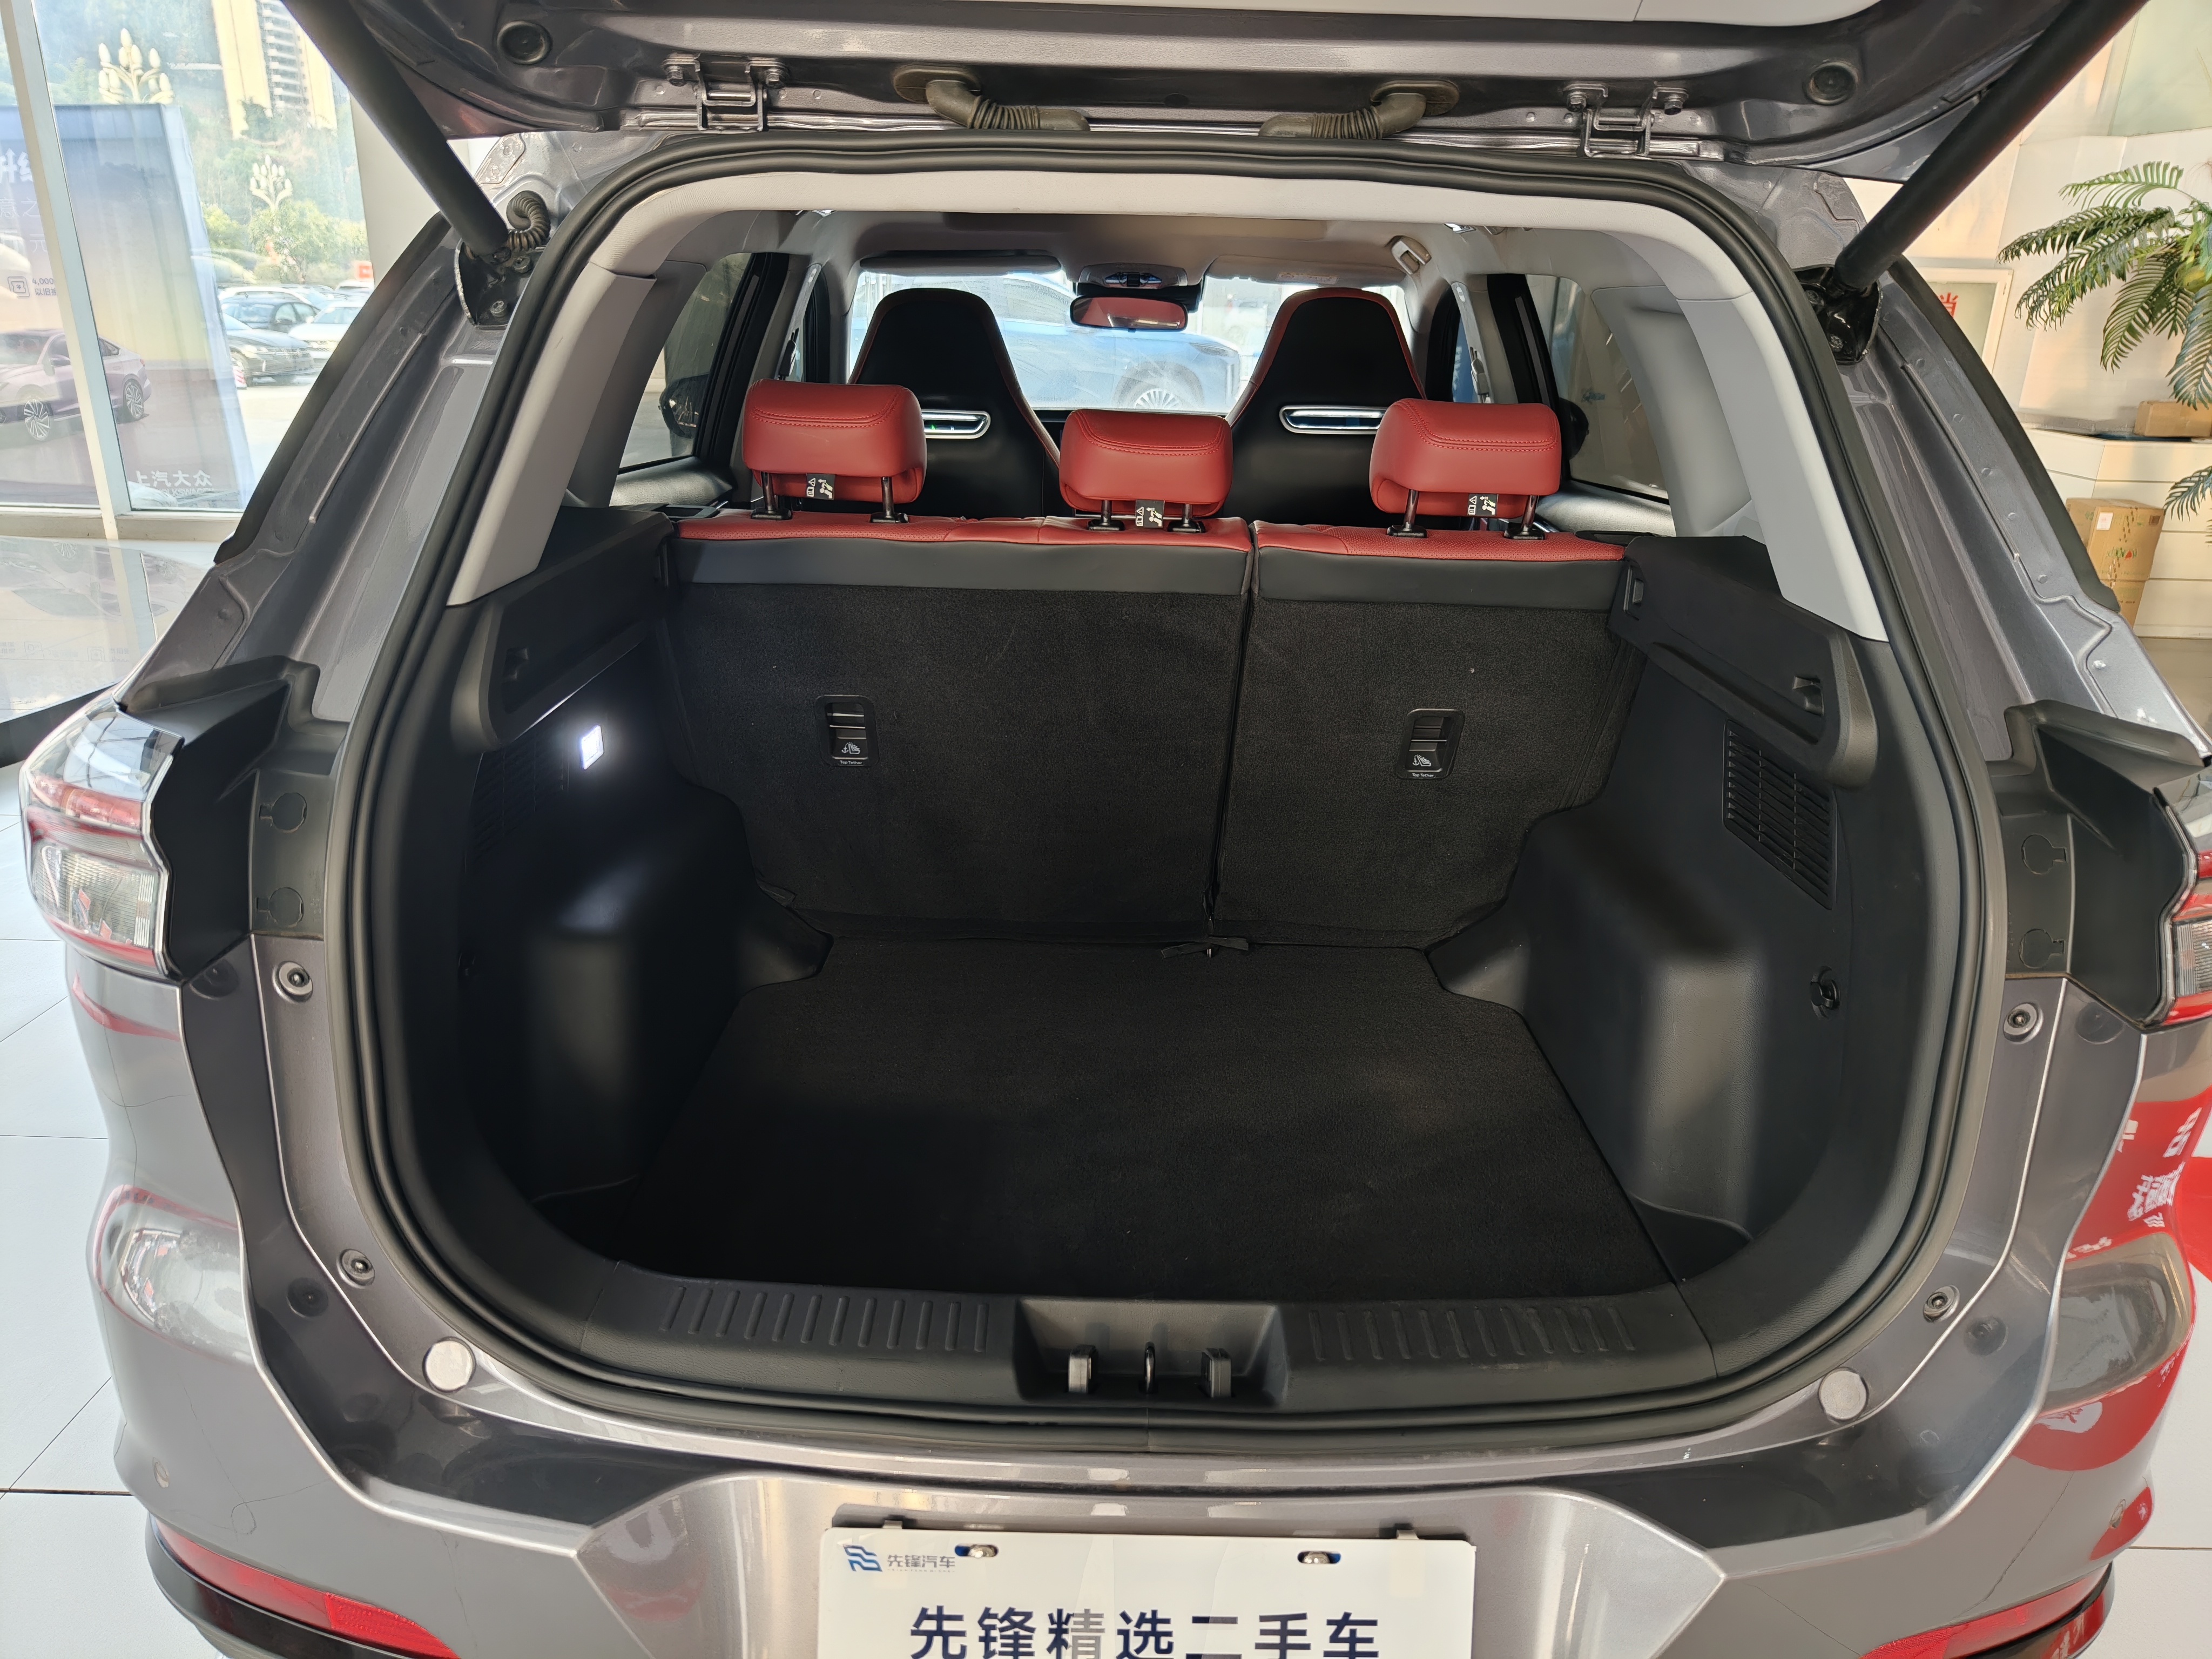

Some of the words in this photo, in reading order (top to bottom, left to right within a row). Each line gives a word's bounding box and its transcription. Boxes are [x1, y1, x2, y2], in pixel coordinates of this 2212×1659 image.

[136, 470, 212, 487] 上汽大众
[887, 1555, 955, 1568] 先锋汽车
[911, 1605, 1379, 1659] 先锋精选二手车
